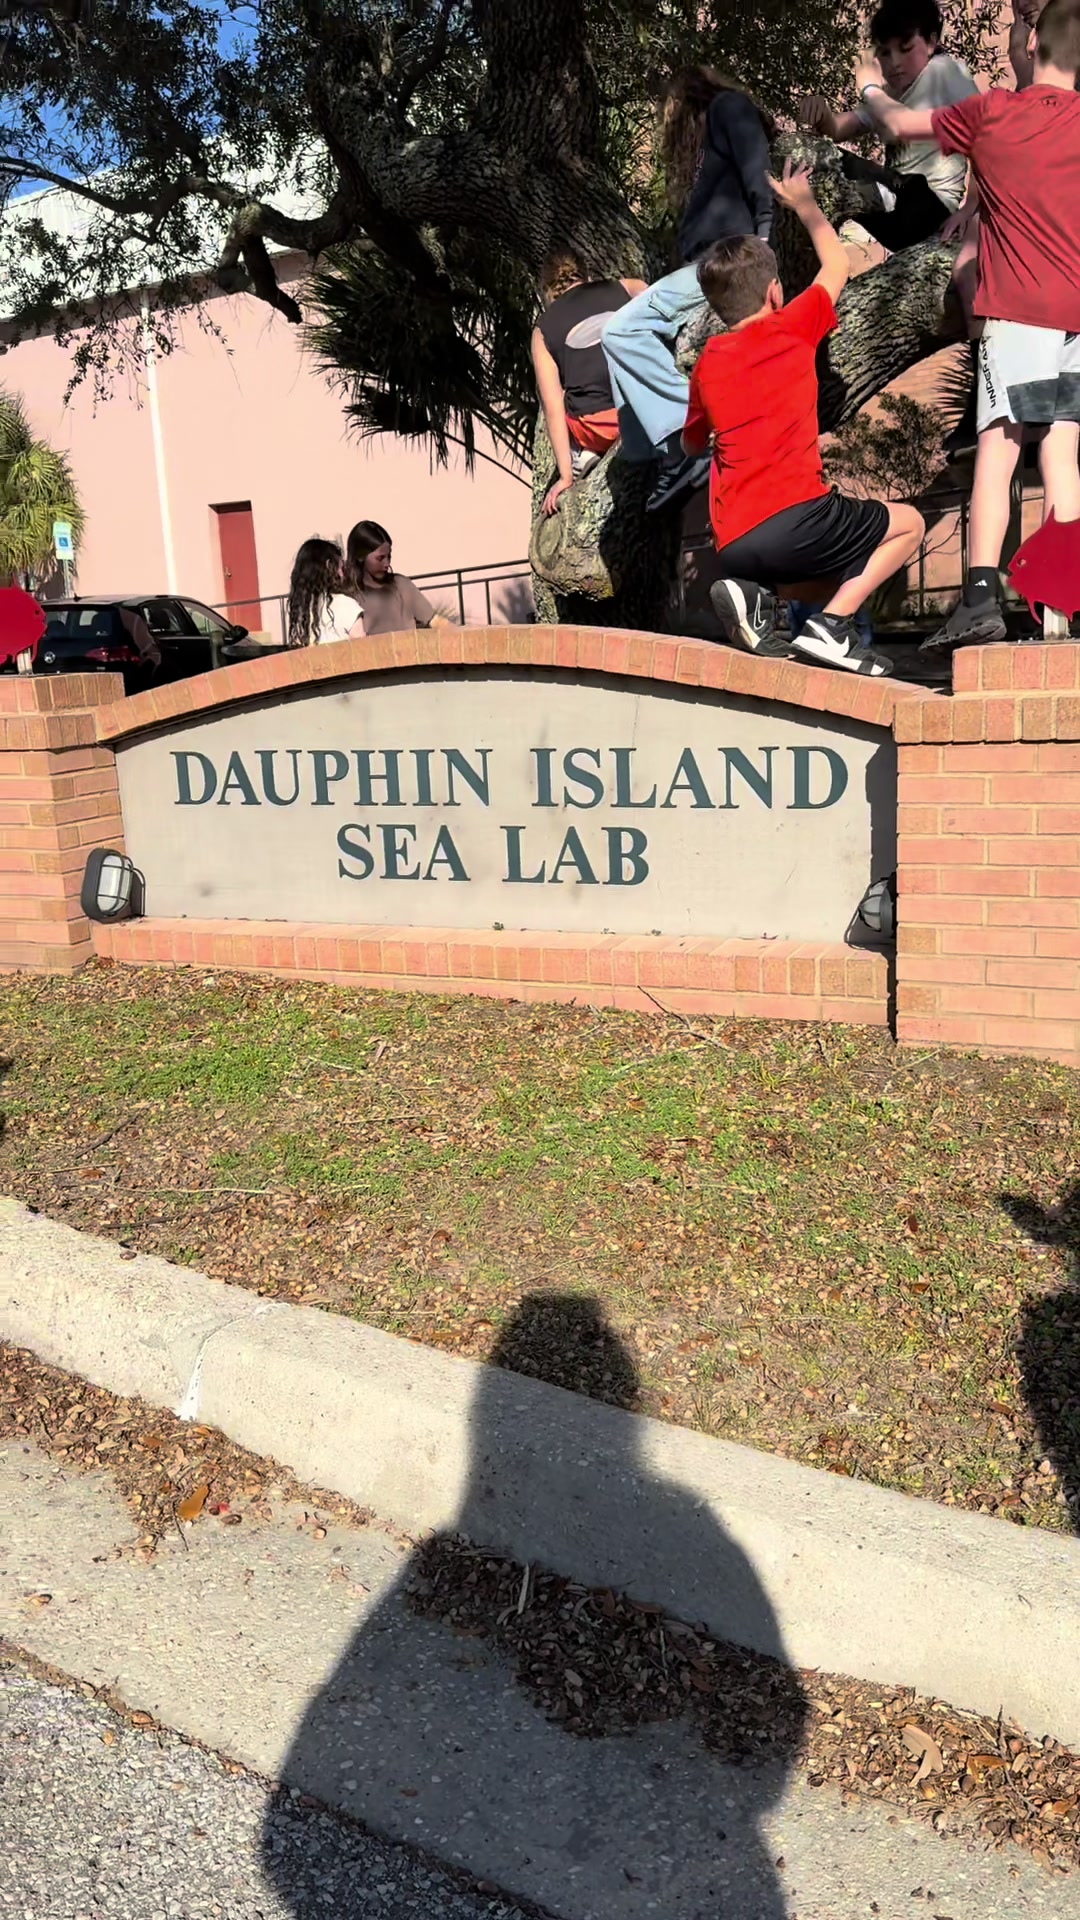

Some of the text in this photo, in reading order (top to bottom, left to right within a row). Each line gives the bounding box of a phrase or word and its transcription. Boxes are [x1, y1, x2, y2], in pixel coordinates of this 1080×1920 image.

[982, 363, 996, 408] UNDER
[170, 746, 849, 809] DAUPHIN ISLAND
[337, 824, 649, 886] SEA LAB
